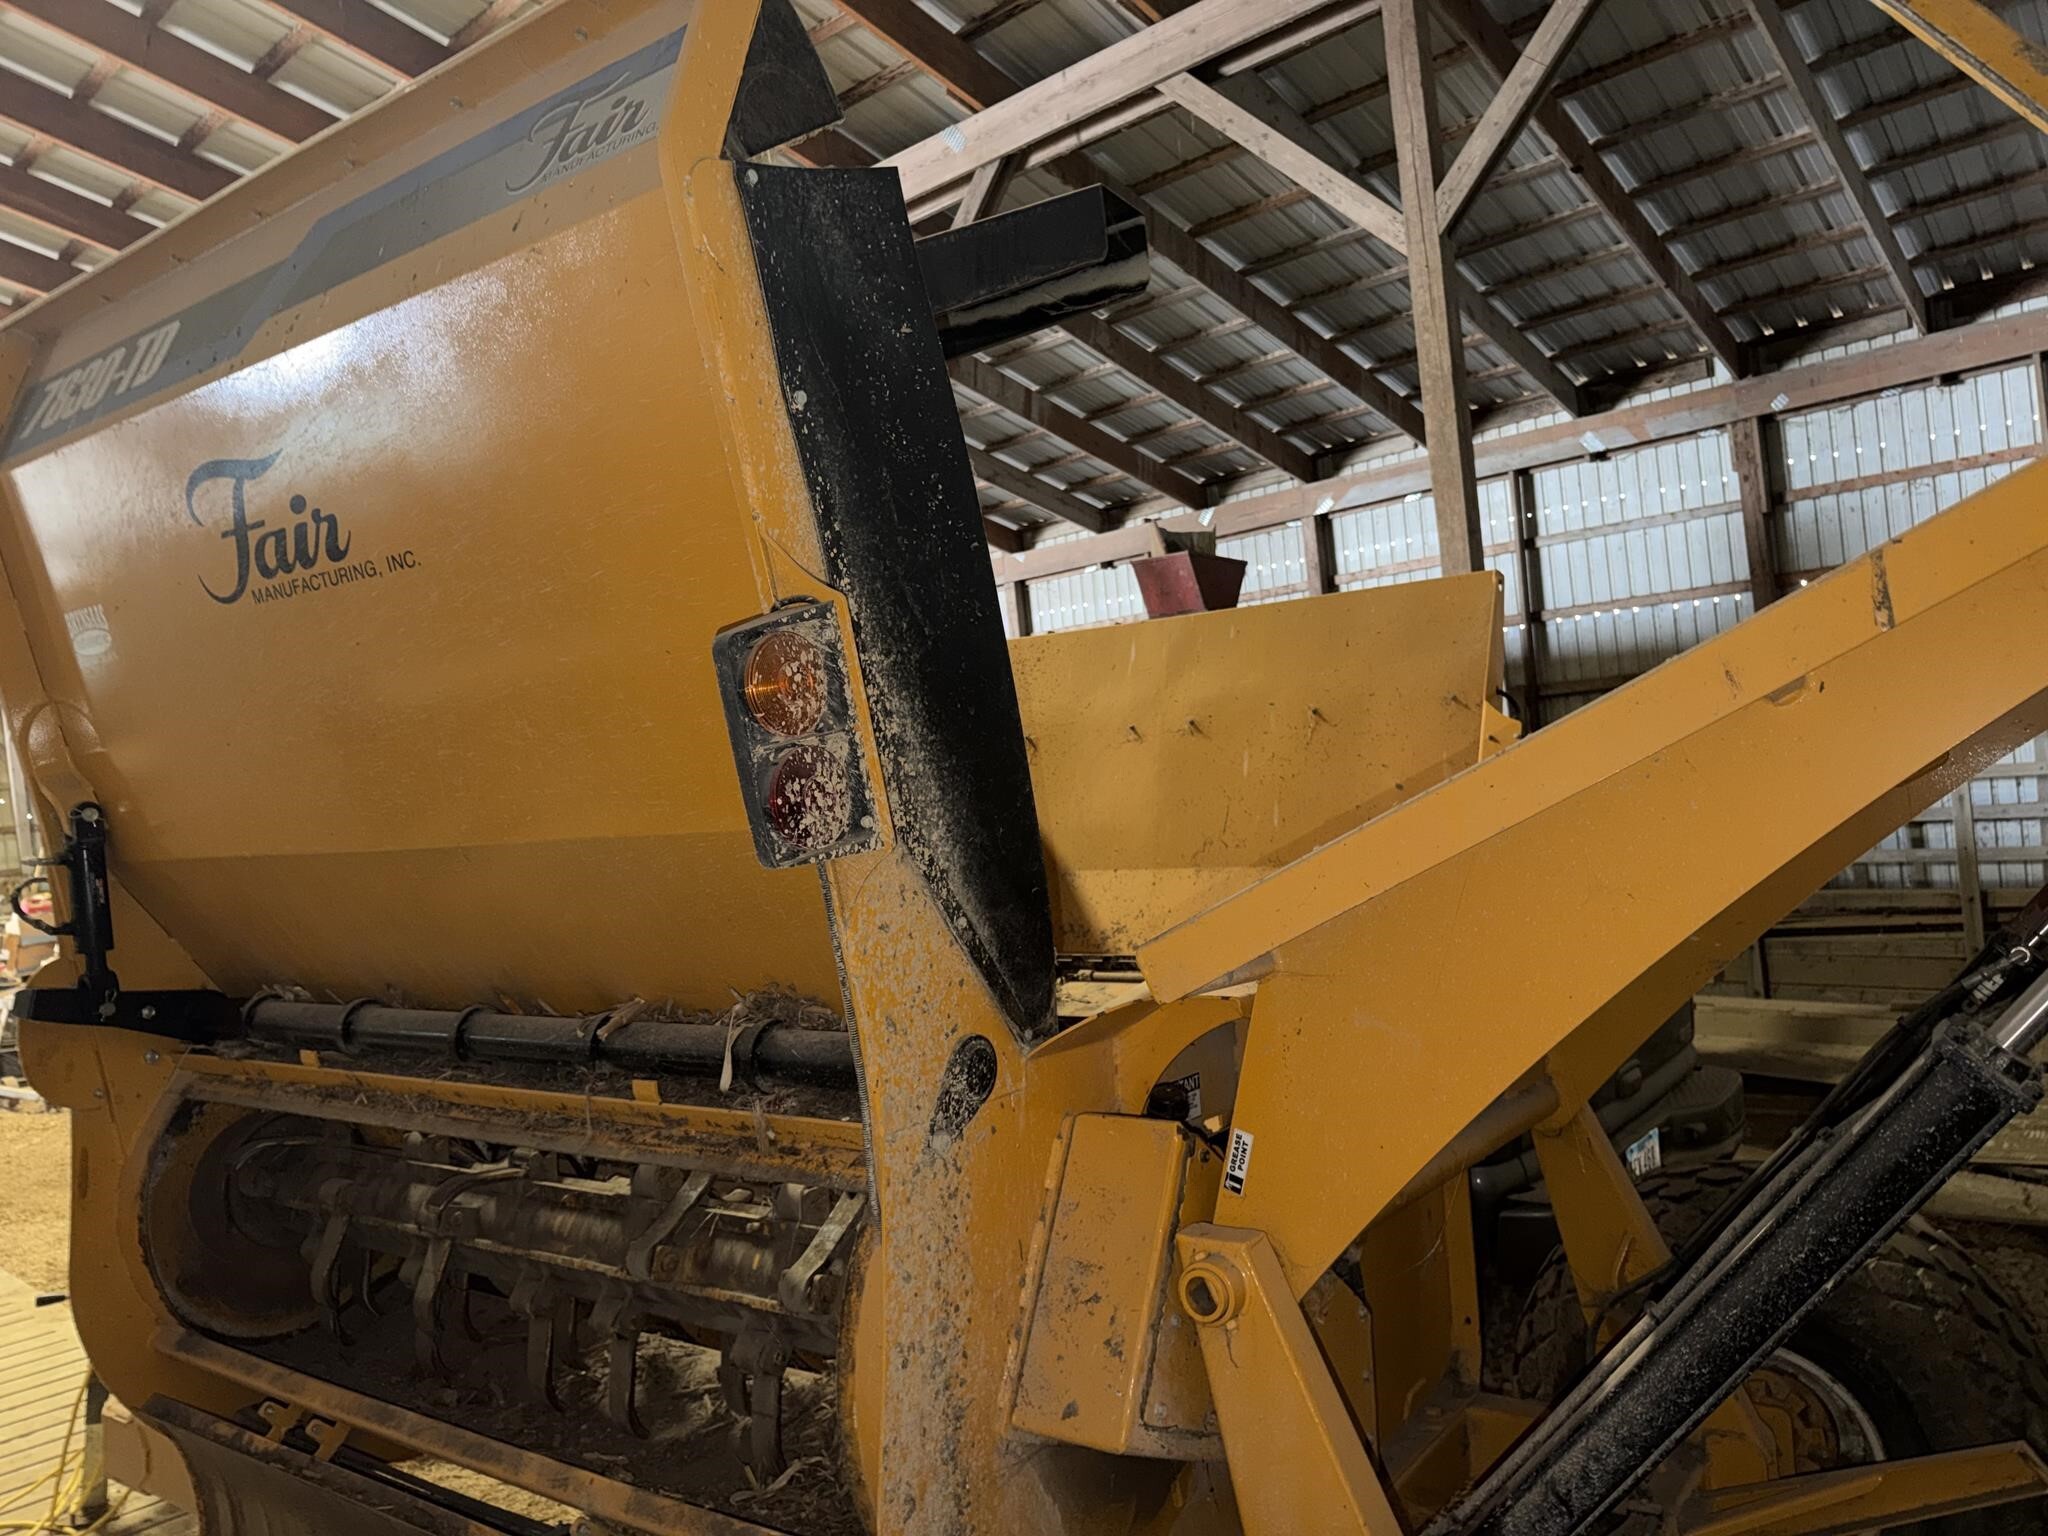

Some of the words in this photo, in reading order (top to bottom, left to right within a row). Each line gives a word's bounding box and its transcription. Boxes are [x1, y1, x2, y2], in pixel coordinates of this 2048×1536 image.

[505, 71, 650, 195] Fair
[185, 447, 351, 604] Fair
[251, 560, 383, 605] MANUFACTURING,
[386, 549, 422, 574] INC.
[1229, 1132, 1243, 1172] GREASE
[1237, 1140, 1249, 1172] POINT
